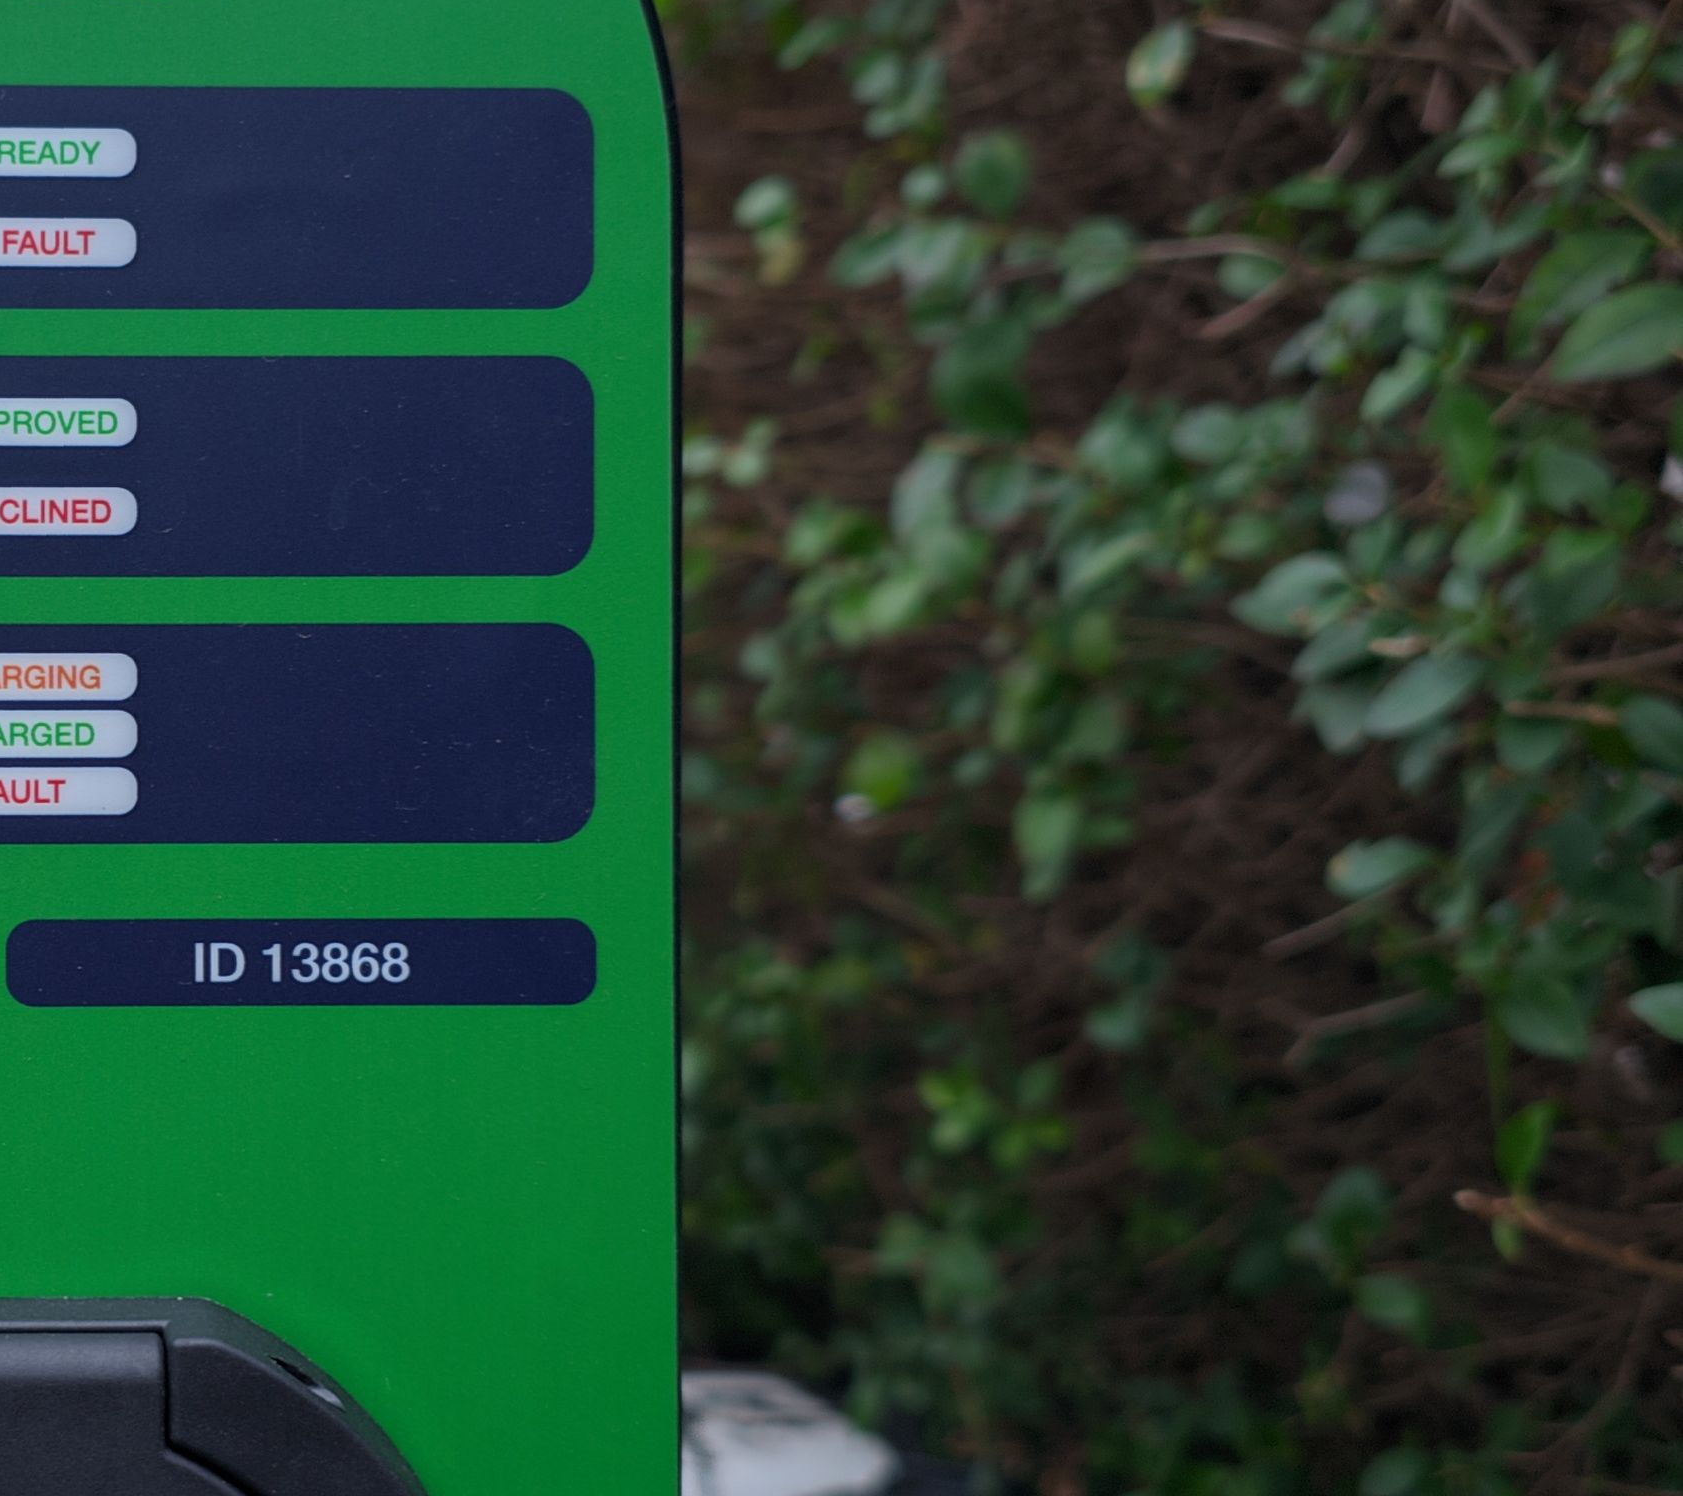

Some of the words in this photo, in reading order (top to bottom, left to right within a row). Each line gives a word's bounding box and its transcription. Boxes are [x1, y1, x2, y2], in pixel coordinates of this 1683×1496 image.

[2, 229, 96, 256] FAULT
[195, 942, 246, 983] ID
[261, 942, 410, 983] 13868
